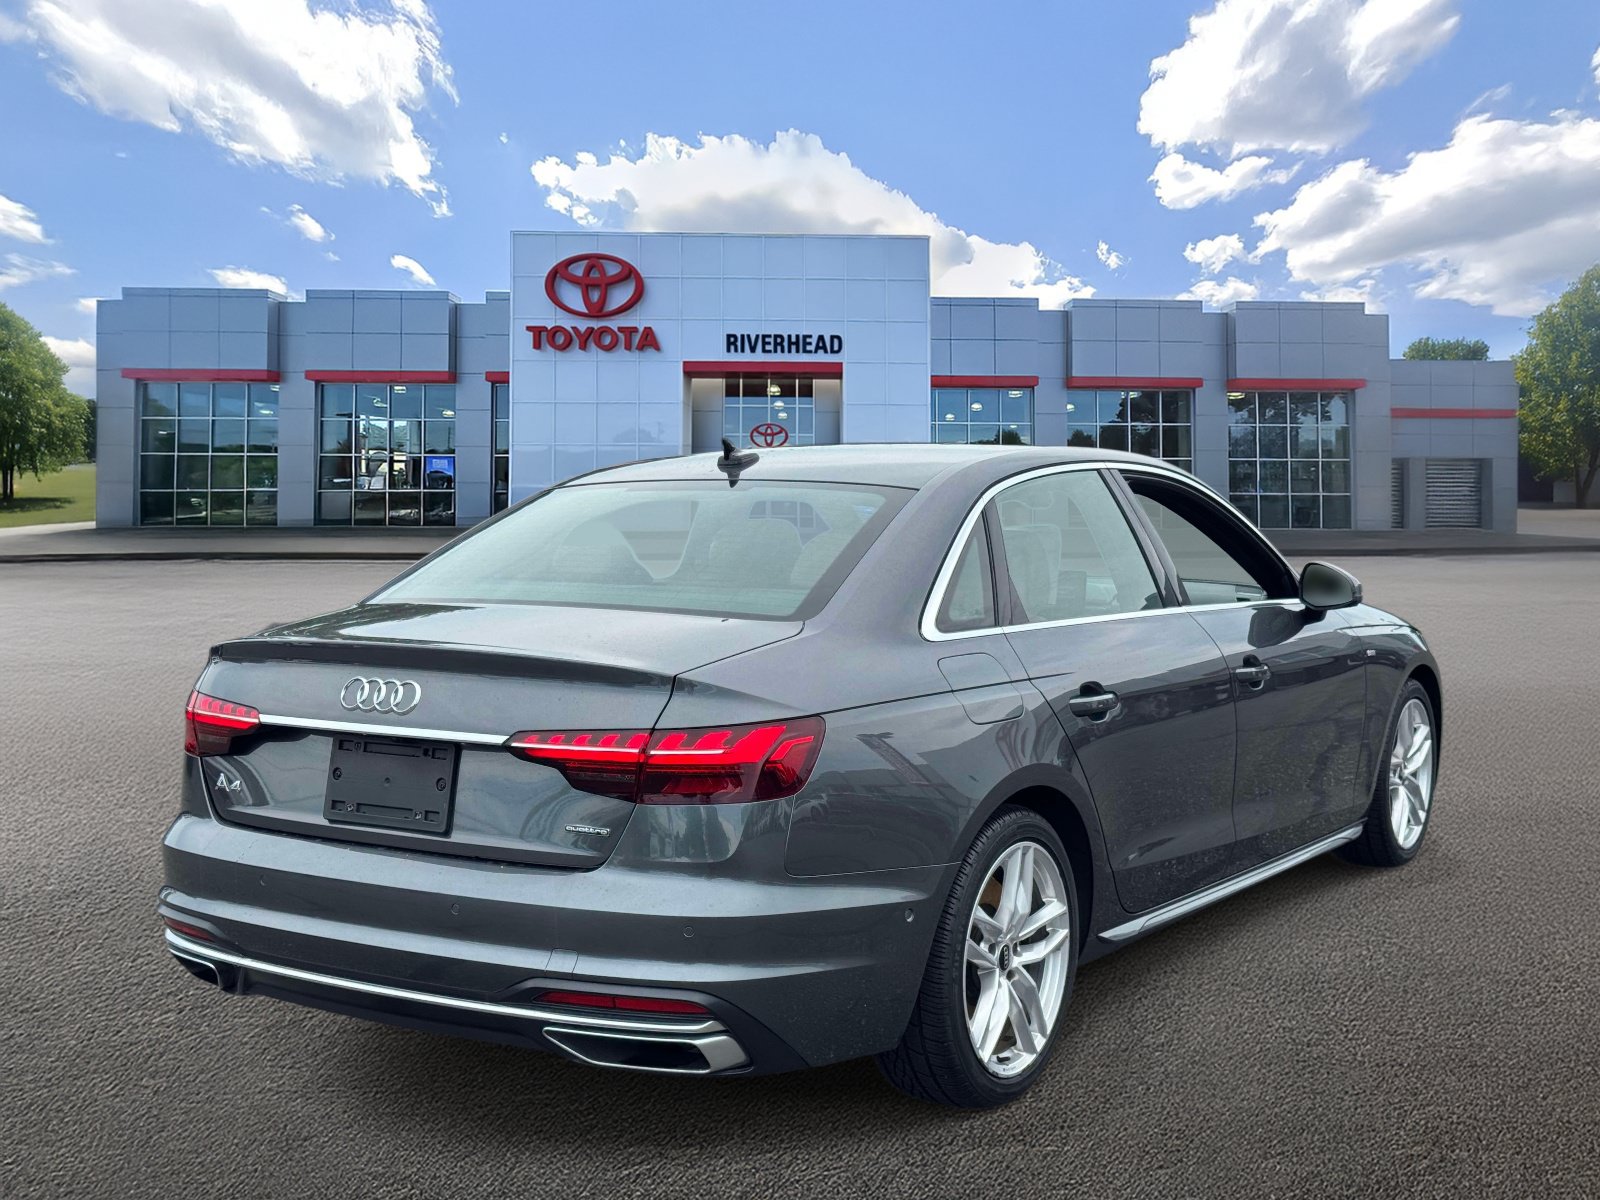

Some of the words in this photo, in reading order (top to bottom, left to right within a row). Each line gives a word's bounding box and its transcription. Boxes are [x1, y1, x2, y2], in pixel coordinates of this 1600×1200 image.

[526, 325, 661, 352] TOYOTA
[726, 333, 843, 354] RIVERHEAD
[215, 772, 241, 792] A4
[565, 825, 608, 836] quattro
